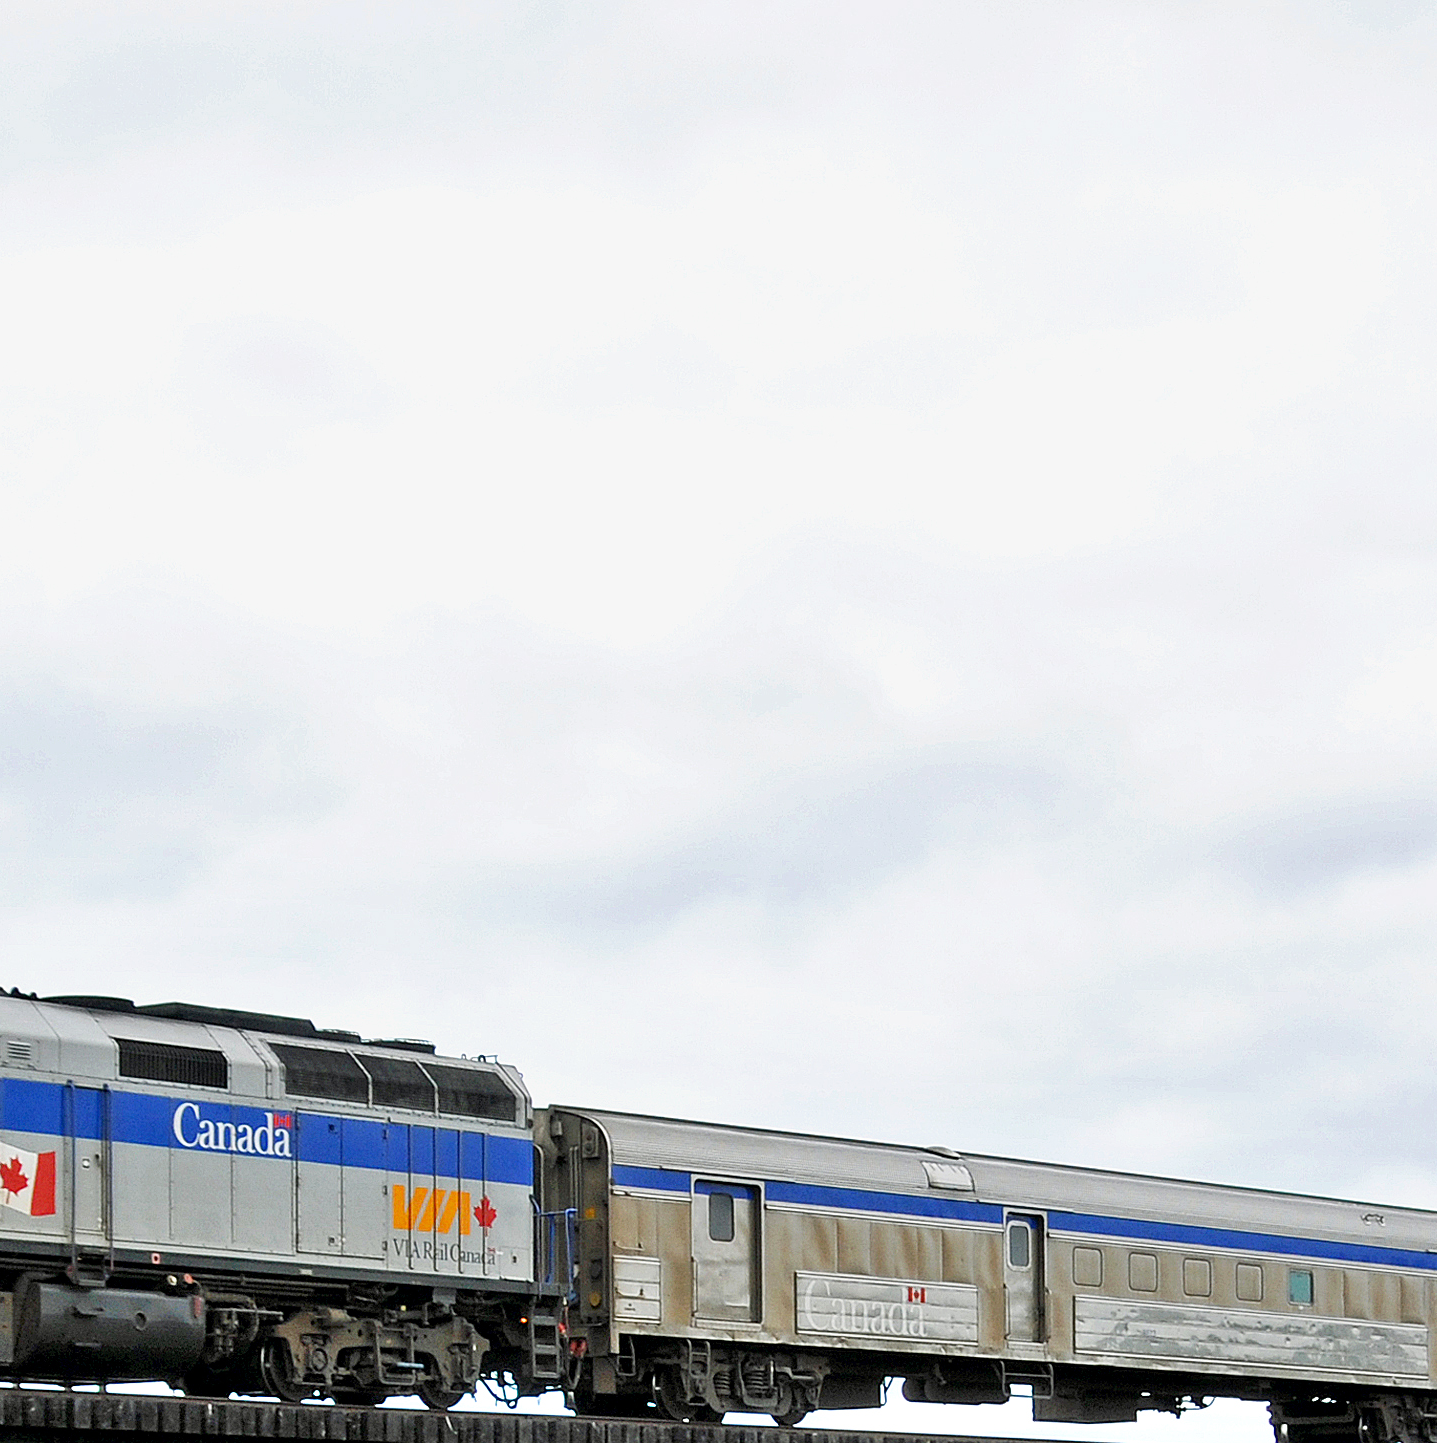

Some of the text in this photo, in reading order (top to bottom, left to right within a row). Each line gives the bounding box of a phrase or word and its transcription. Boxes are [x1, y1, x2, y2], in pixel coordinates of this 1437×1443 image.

[173, 1102, 292, 1157] Canada
[392, 1184, 471, 1236] VIA
[393, 1238, 421, 1259] VIA
[805, 1279, 927, 1337] Canada
